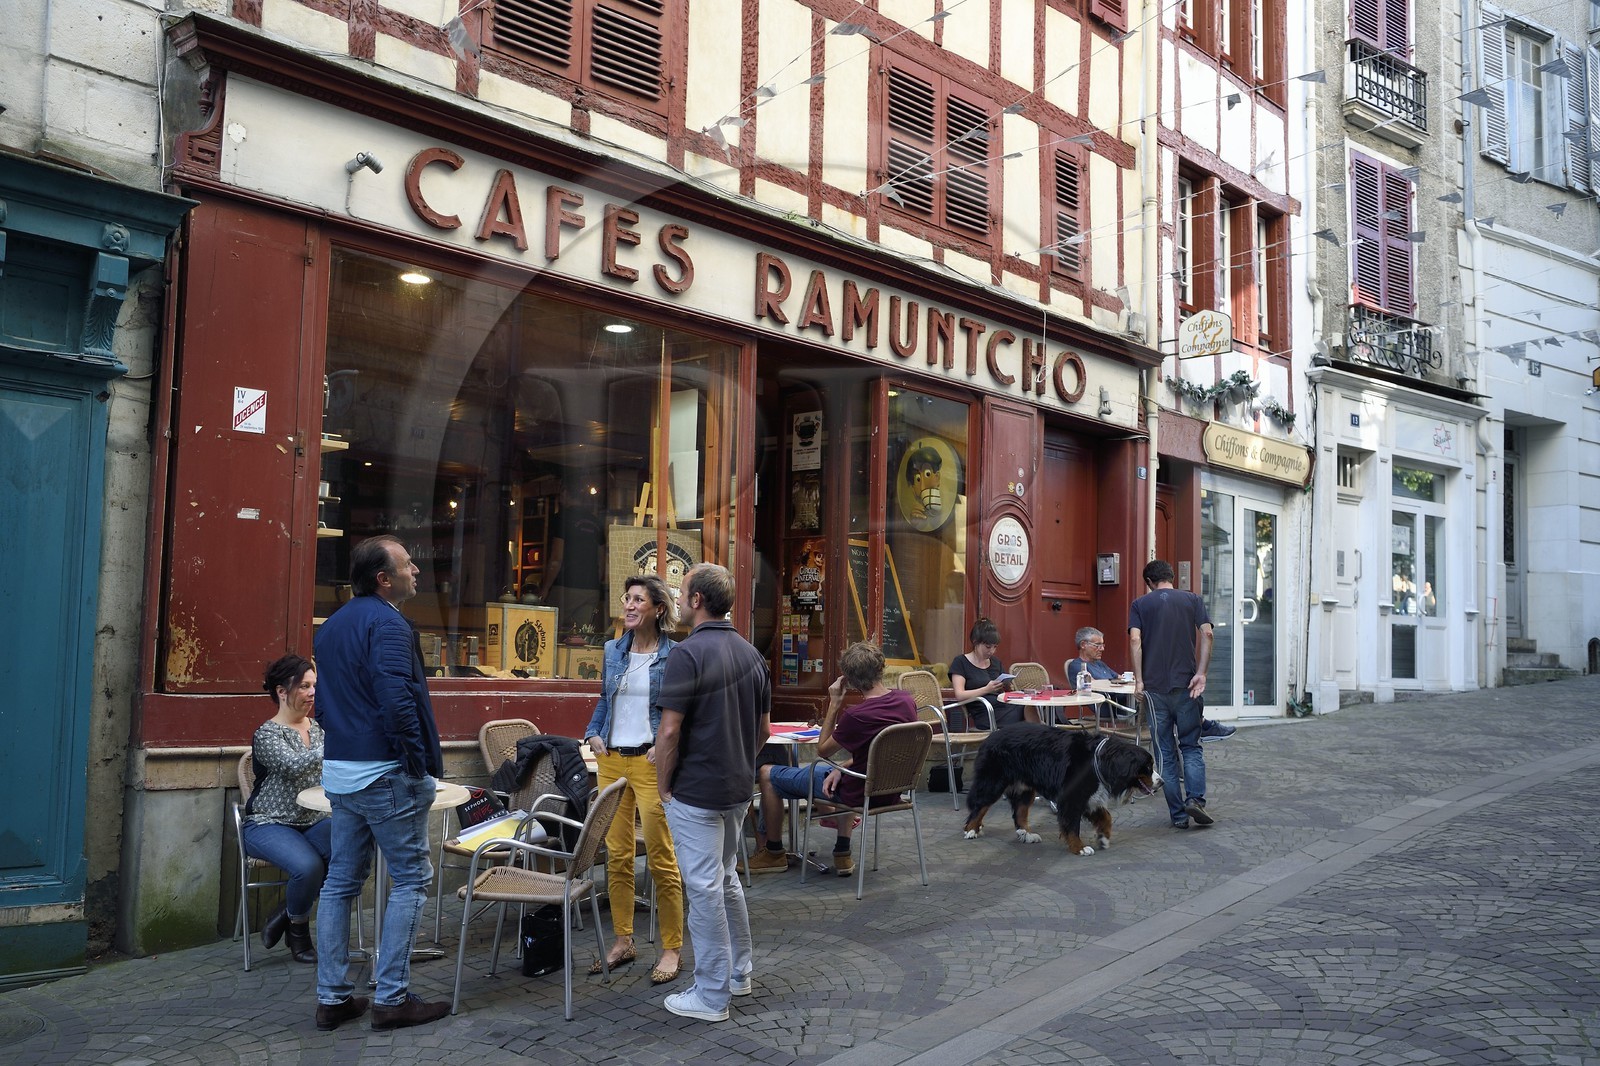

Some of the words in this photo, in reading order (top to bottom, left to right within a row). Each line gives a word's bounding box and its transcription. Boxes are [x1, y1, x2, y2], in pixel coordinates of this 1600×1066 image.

[404, 147, 695, 295] CAFES
[754, 252, 1087, 403] RAMUNTCHO
[1181, 338, 1229, 354] Compagnie
[1531, 361, 1540, 374] 15
[237, 390, 246, 399] IV
[236, 395, 265, 425] LICENCE
[1352, 415, 1359, 425] 13
[1214, 434, 1249, 459] Chiffons
[1250, 445, 1258, 460] &
[1259, 447, 1303, 474] Compagnie
[534, 619, 547, 650] Skybury
[464, 797, 488, 812] SEPHORA
